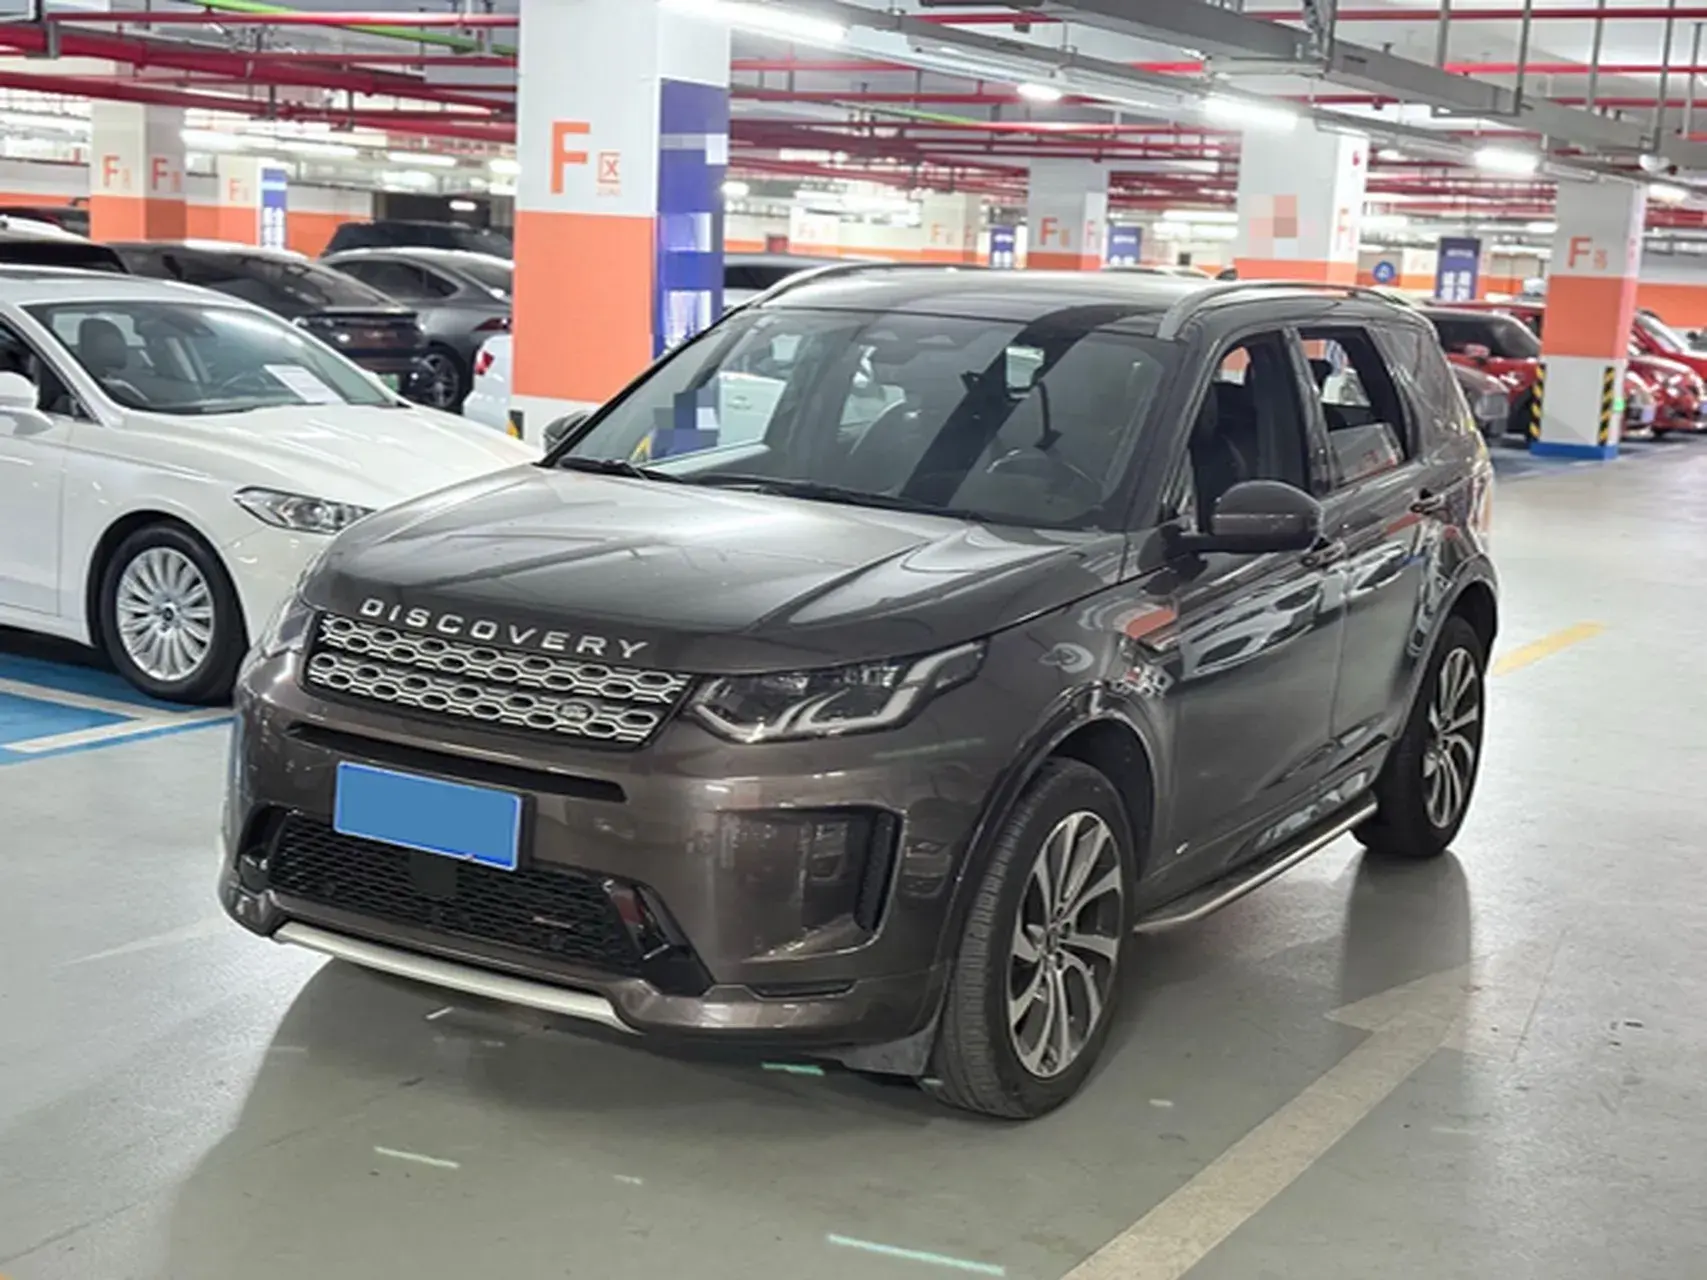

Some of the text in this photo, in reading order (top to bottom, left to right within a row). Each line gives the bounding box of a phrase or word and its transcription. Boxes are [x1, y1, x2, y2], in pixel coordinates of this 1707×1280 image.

[103, 155, 120, 187] F
[152, 157, 168, 190] F
[551, 121, 590, 194] F
[228, 178, 241, 202] F
[1040, 218, 1058, 245] F
[1568, 236, 1593, 269] F
[361, 598, 648, 660] DISCOVERY
